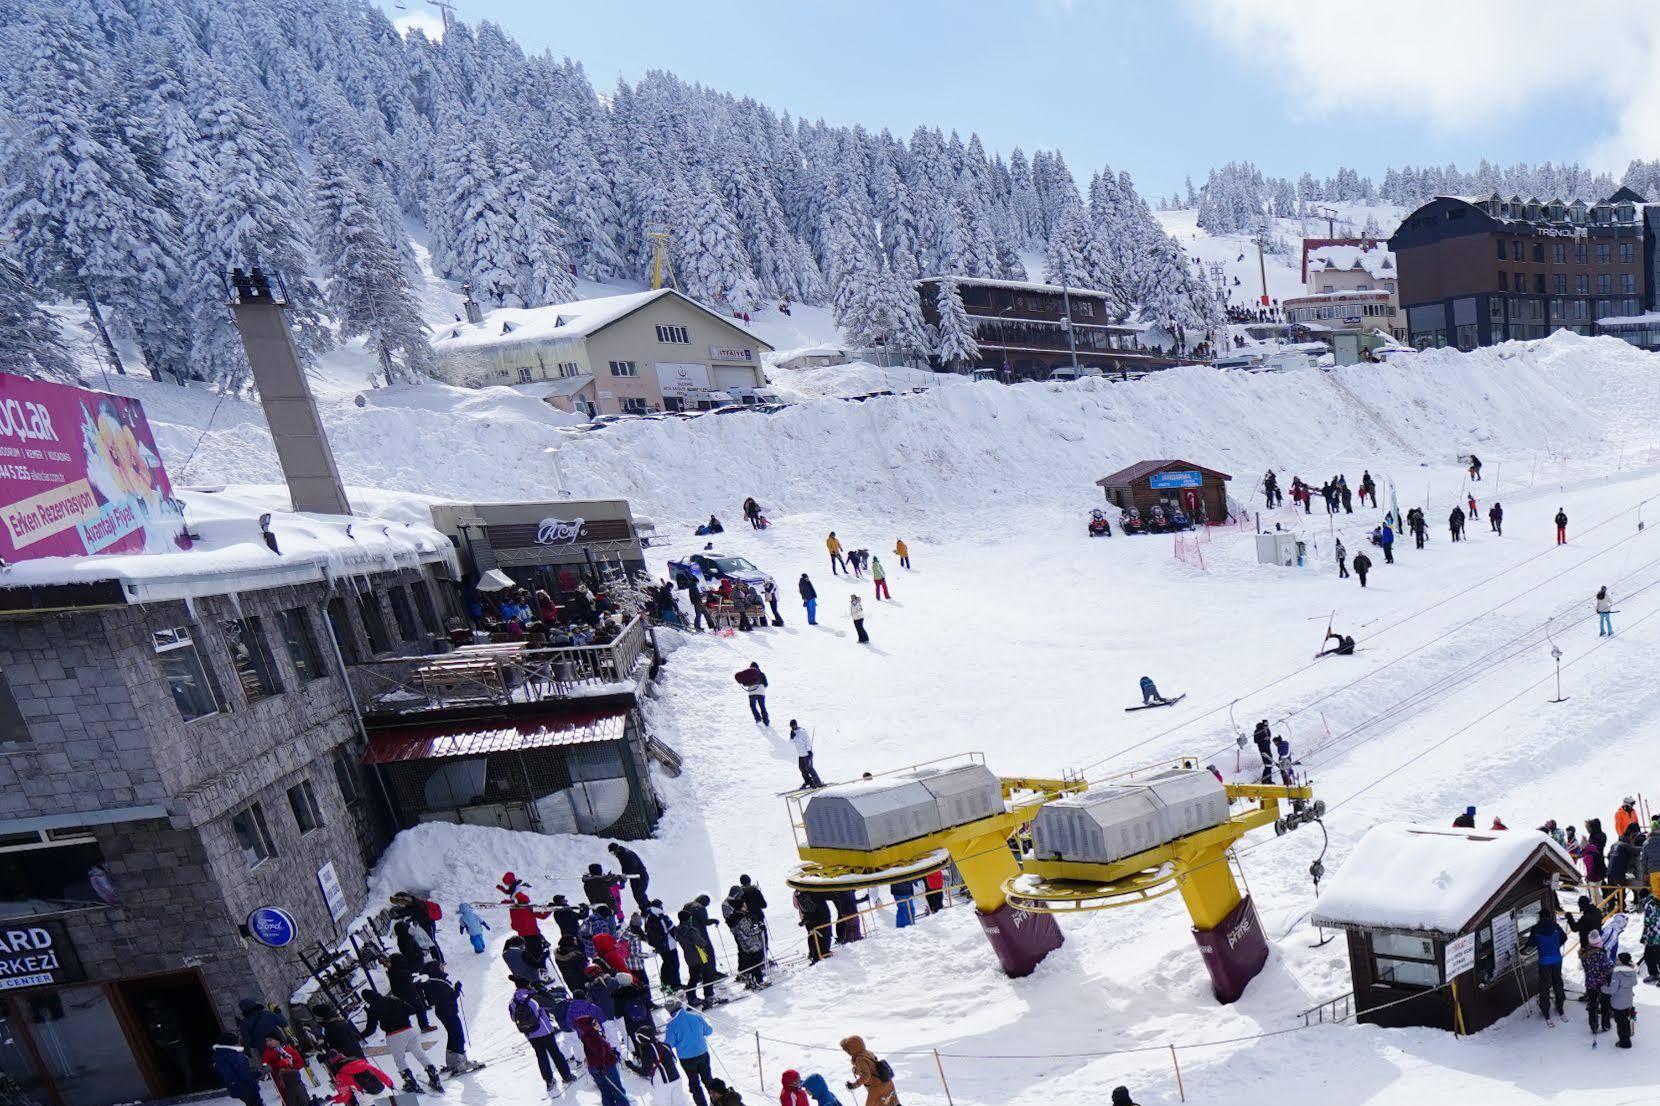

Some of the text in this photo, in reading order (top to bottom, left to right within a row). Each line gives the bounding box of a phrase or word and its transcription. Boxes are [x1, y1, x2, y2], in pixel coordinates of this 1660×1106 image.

[9, 492, 94, 537] Erken Rezervasyon
[256, 918, 285, 930] Ford
[7, 974, 50, 987] CENTER
